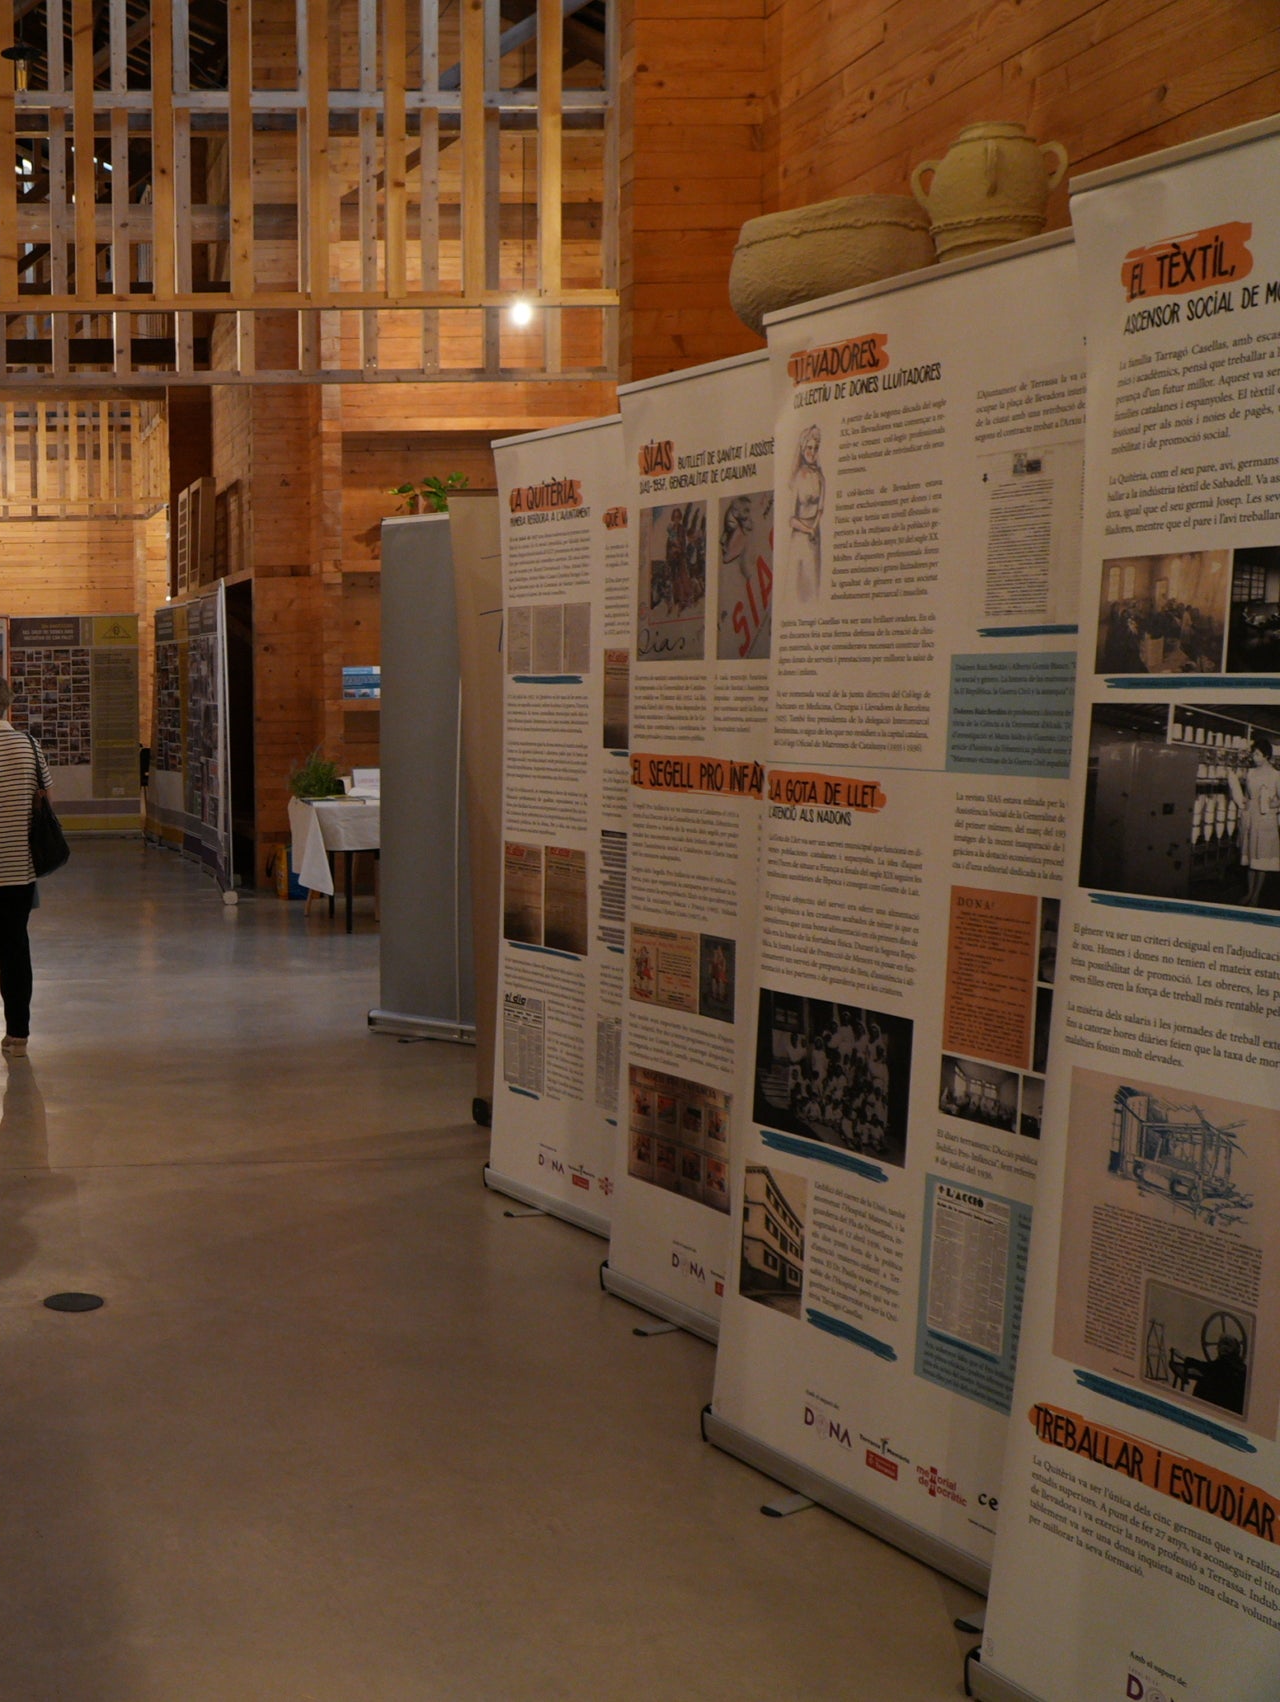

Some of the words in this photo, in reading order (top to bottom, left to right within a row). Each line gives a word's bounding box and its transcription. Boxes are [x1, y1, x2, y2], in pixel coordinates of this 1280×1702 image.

[1130, 263, 1146, 299] EL
[1123, 302, 1180, 336] ASCENSOR
[1187, 290, 1234, 320] SOCIAL
[1241, 285, 1260, 310] DE
[834, 382, 846, 400] DE
[849, 376, 878, 397] DONES
[882, 362, 942, 391] LLUITADORES
[1185, 391, 1233, 409] espanyoles.
[1238, 386, 1247, 397] El
[1250, 380, 1275, 394] tèxtil
[1202, 410, 1225, 422] noies
[1228, 407, 1240, 418] de
[644, 439, 672, 475] SIAS
[708, 450, 716, 466] DE
[718, 444, 743, 464] SANITAT
[710, 470, 719, 483] DE
[720, 463, 758, 482] CATALUNYA
[511, 488, 522, 512] LA
[633, 760, 644, 785] EL
[649, 760, 694, 789] SEGELL
[700, 762, 724, 791] PRO
[786, 780, 818, 804] GOTA
[824, 782, 842, 805] DE
[848, 784, 877, 808] LLET
[987, 794, 1002, 804] SIAS
[800, 808, 815, 823] ALS
[816, 809, 852, 826] NADONS
[1097, 944, 1124, 956] Homes
[1133, 949, 1158, 961] dones
[1176, 958, 1205, 968] tenien
[1208, 961, 1216, 970] el
[1219, 965, 1250, 975] mateix
[1147, 971, 1192, 984] promoció.
[1196, 976, 1211, 987] Les
[1216, 979, 1252, 995] obreres,
[1256, 985, 1268, 996] les
[538, 1154, 564, 1175] DNA
[672, 1254, 706, 1280] DNA
[1034, 1404, 1144, 1483] TREBALLAR
[1170, 1465, 1275, 1542] ESTUDIAR
[1044, 1459, 1075, 1482] Quitèria
[1079, 1478, 1087, 1488] va
[1104, 1487, 1130, 1508] l'única
[1133, 1500, 1150, 1517] dels
[1153, 1512, 1170, 1527] cinc
[1173, 1522, 1211, 1546] germans
[1214, 1541, 1230, 1555] que
[1233, 1550, 1243, 1561] va
[1083, 1511, 1092, 1521] va
[1095, 1517, 1122, 1535] exercir
[1125, 1528, 1132, 1540] la
[1135, 1536, 1155, 1551] nova
[1158, 1547, 1196, 1571] professió
[1207, 1567, 1246, 1595] Terrassa.
[1130, 1514, 1139, 1528] de
[1155, 1526, 1165, 1540] 27
[1167, 1535, 1188, 1552] anys,
[1191, 1547, 1201, 1558] va
[1203, 1552, 1251, 1581] aconseguir
[1254, 1575, 1261, 1586] el
[1096, 1532, 1110, 1545] una
[1114, 1538, 1134, 1557] dona
[1137, 1549, 1172, 1575] inquieta
[1176, 1570, 1194, 1586] amb
[1198, 1582, 1214, 1596] una
[1217, 1590, 1238, 1607] clara
